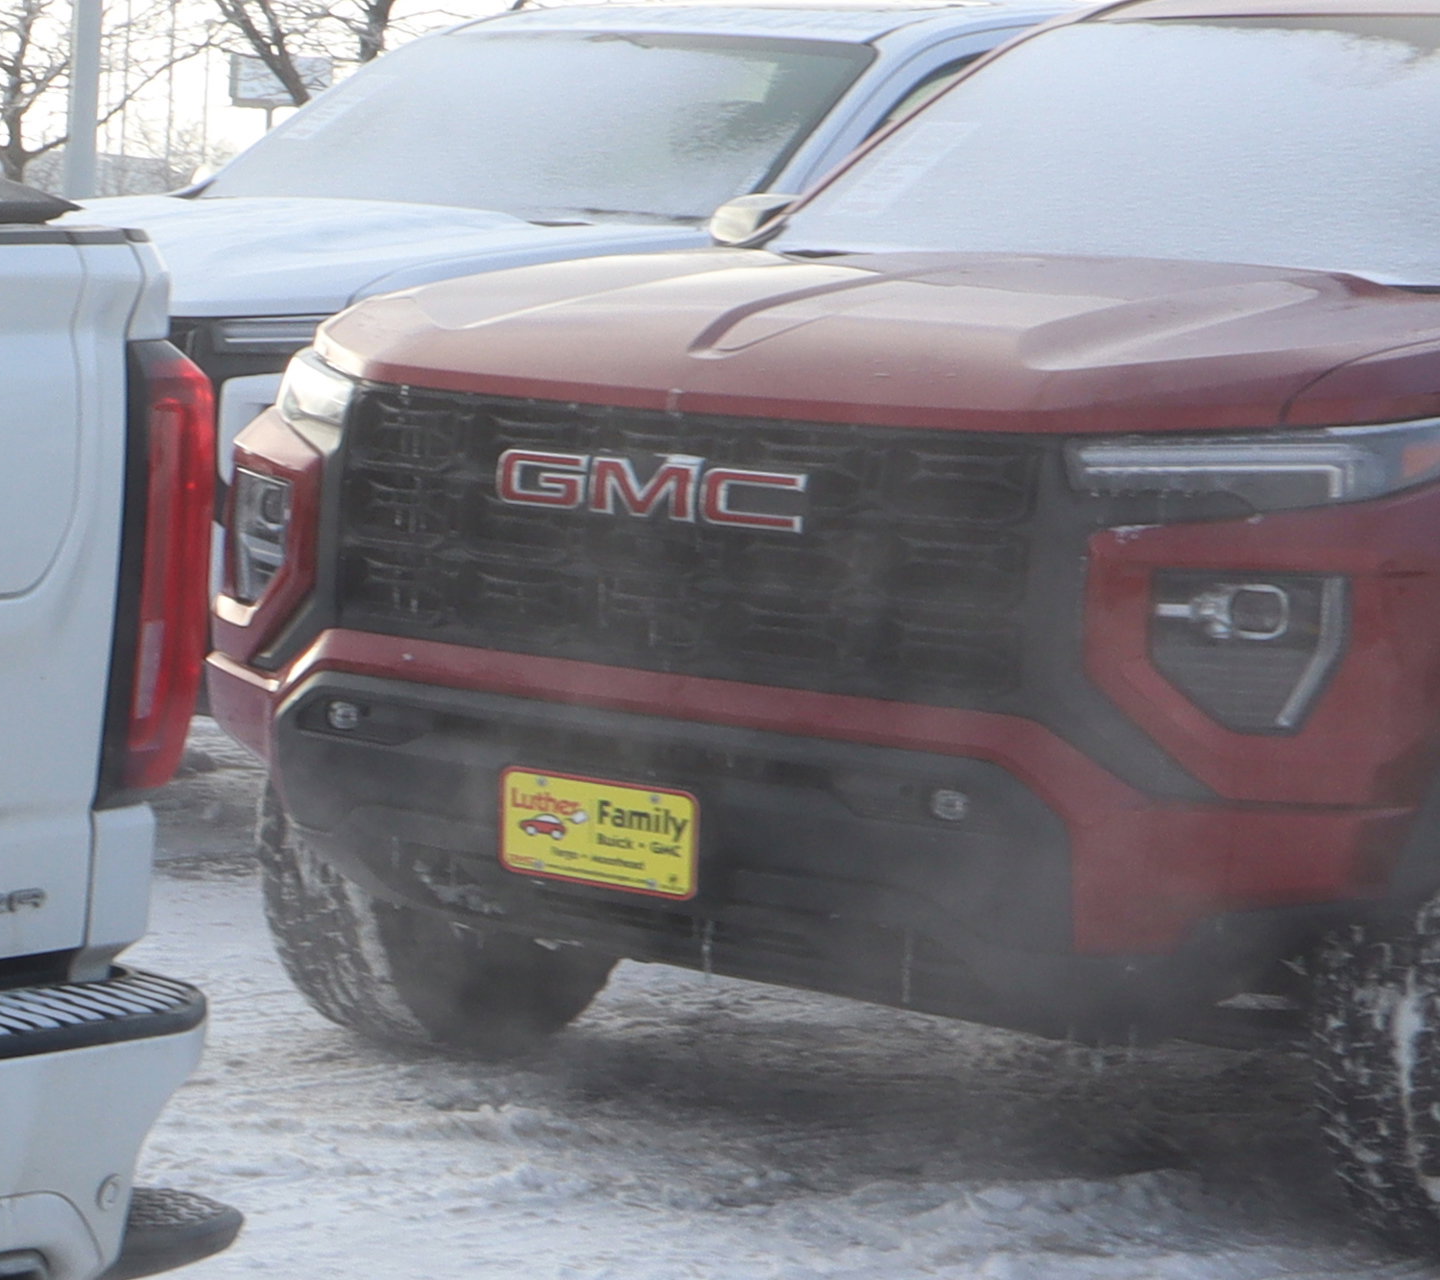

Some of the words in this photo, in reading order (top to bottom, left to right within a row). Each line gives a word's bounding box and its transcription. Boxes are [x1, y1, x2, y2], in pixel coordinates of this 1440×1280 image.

[496, 449, 807, 534] GMC
[511, 787, 580, 815] Luther
[597, 800, 689, 840] Family
